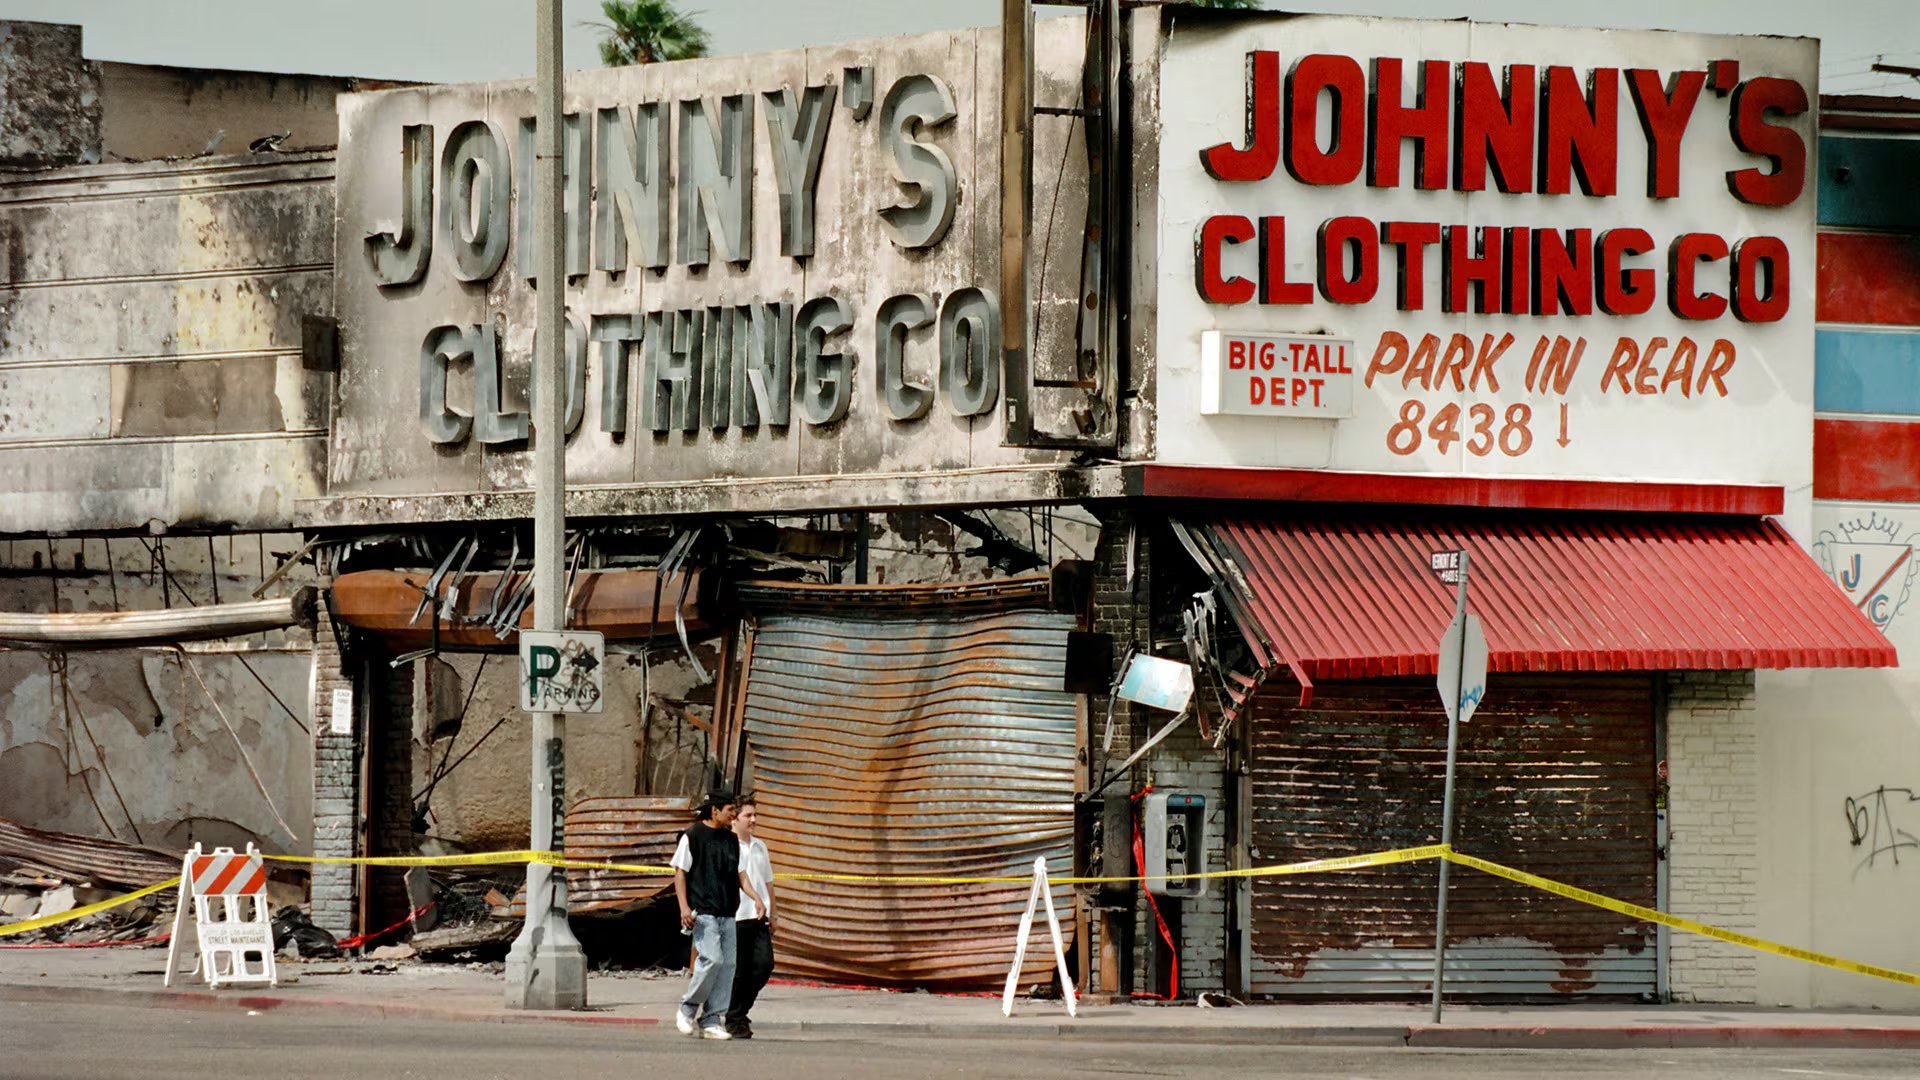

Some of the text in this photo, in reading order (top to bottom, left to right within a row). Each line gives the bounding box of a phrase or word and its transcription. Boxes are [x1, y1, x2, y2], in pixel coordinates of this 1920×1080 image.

[1199, 50, 1809, 207] JOHNNY'S
[364, 66, 958, 286] JOHNNY'S
[1195, 214, 1791, 323] CLOTHING CO
[876, 287, 999, 420] CO
[1364, 330, 1736, 399] PARK IN REAR
[1386, 399, 1533, 456] 8438
[1840, 554, 1861, 592] J
[1867, 594, 1889, 627] C
